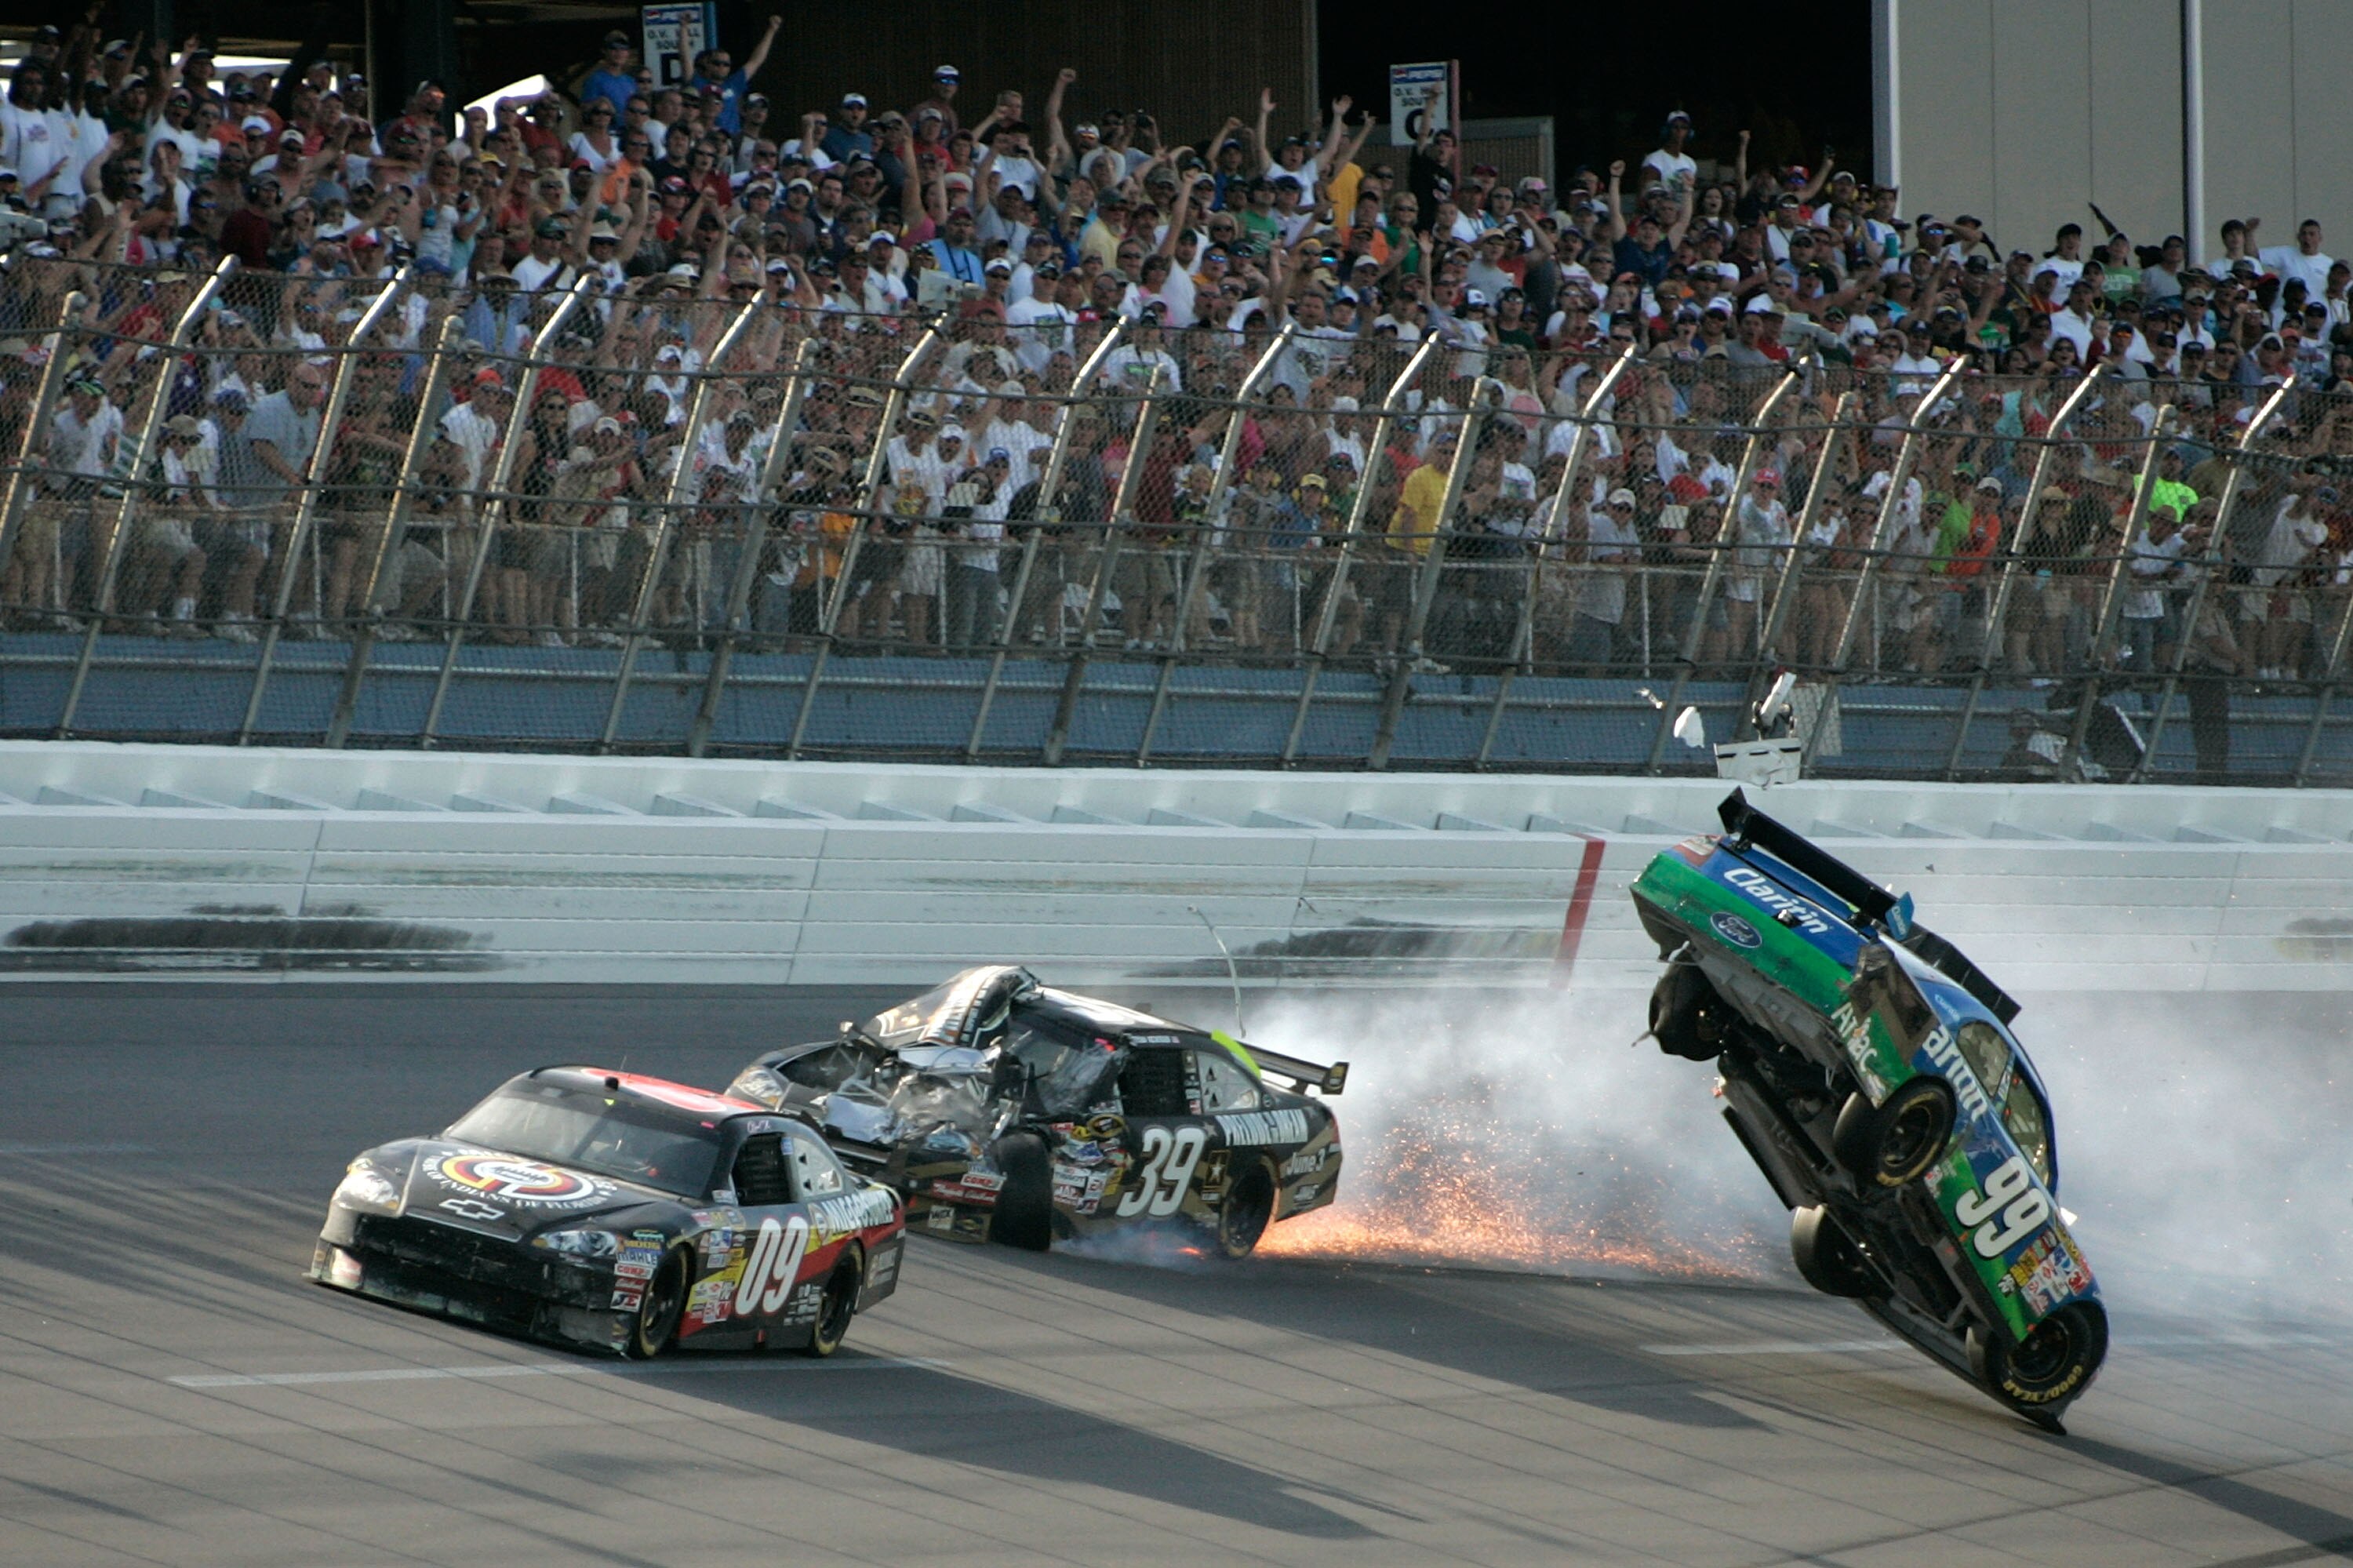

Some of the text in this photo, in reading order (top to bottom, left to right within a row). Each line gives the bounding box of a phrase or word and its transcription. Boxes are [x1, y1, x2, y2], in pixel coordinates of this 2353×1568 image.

[1724, 868, 1829, 935] Claritin
[1718, 916, 1755, 943] Ford
[1115, 1127, 1207, 1217] 39
[1286, 1148, 1326, 1176] June 3
[1955, 1155, 2049, 1258] 99
[617, 1252, 658, 1265] MAHLE
[736, 1216, 809, 1315] 09
[2002, 1364, 2083, 1404] GOODYEAR
